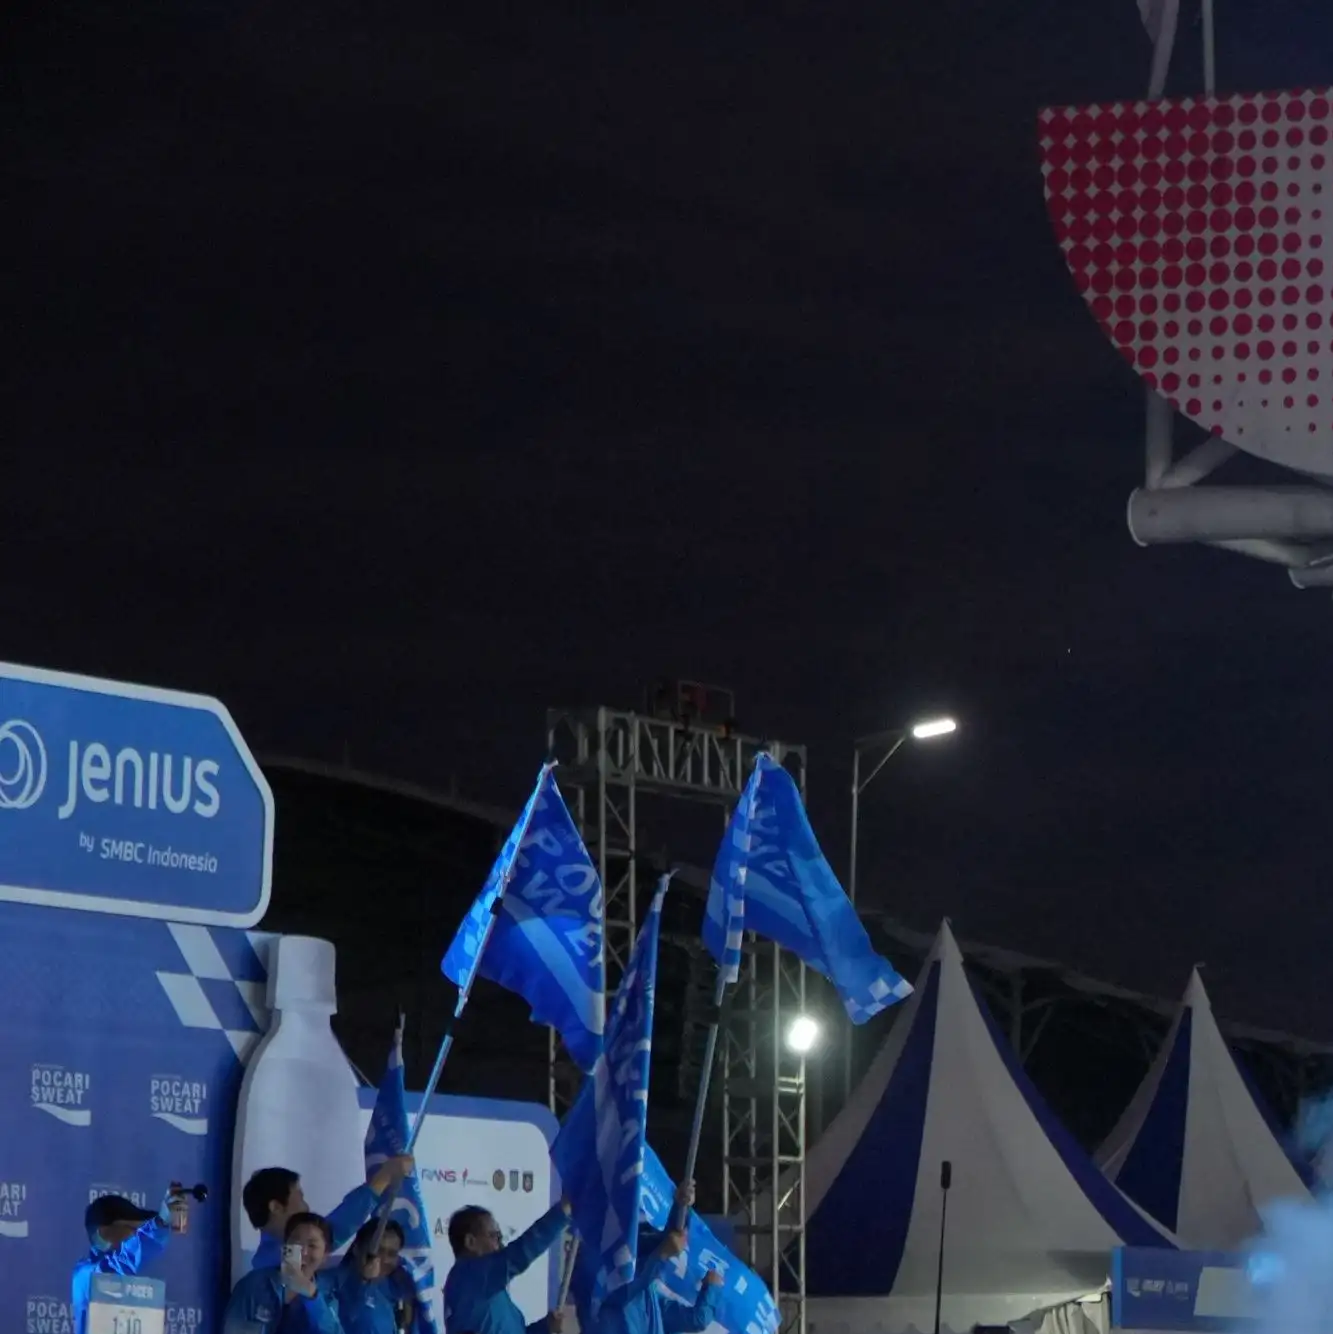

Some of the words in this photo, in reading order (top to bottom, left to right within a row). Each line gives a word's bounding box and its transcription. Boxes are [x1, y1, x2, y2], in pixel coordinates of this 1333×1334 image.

[80, 832, 94, 852] by
[101, 838, 144, 863] SMBC
[148, 846, 218, 873] Indonesia
[32, 1069, 90, 1089] POCARI
[31, 1086, 84, 1105] SWEAT
[151, 1080, 207, 1099] POCARI
[151, 1097, 201, 1113] SWEAT
[27, 1301, 73, 1319] POCA
[167, 1308, 201, 1322] CARI
